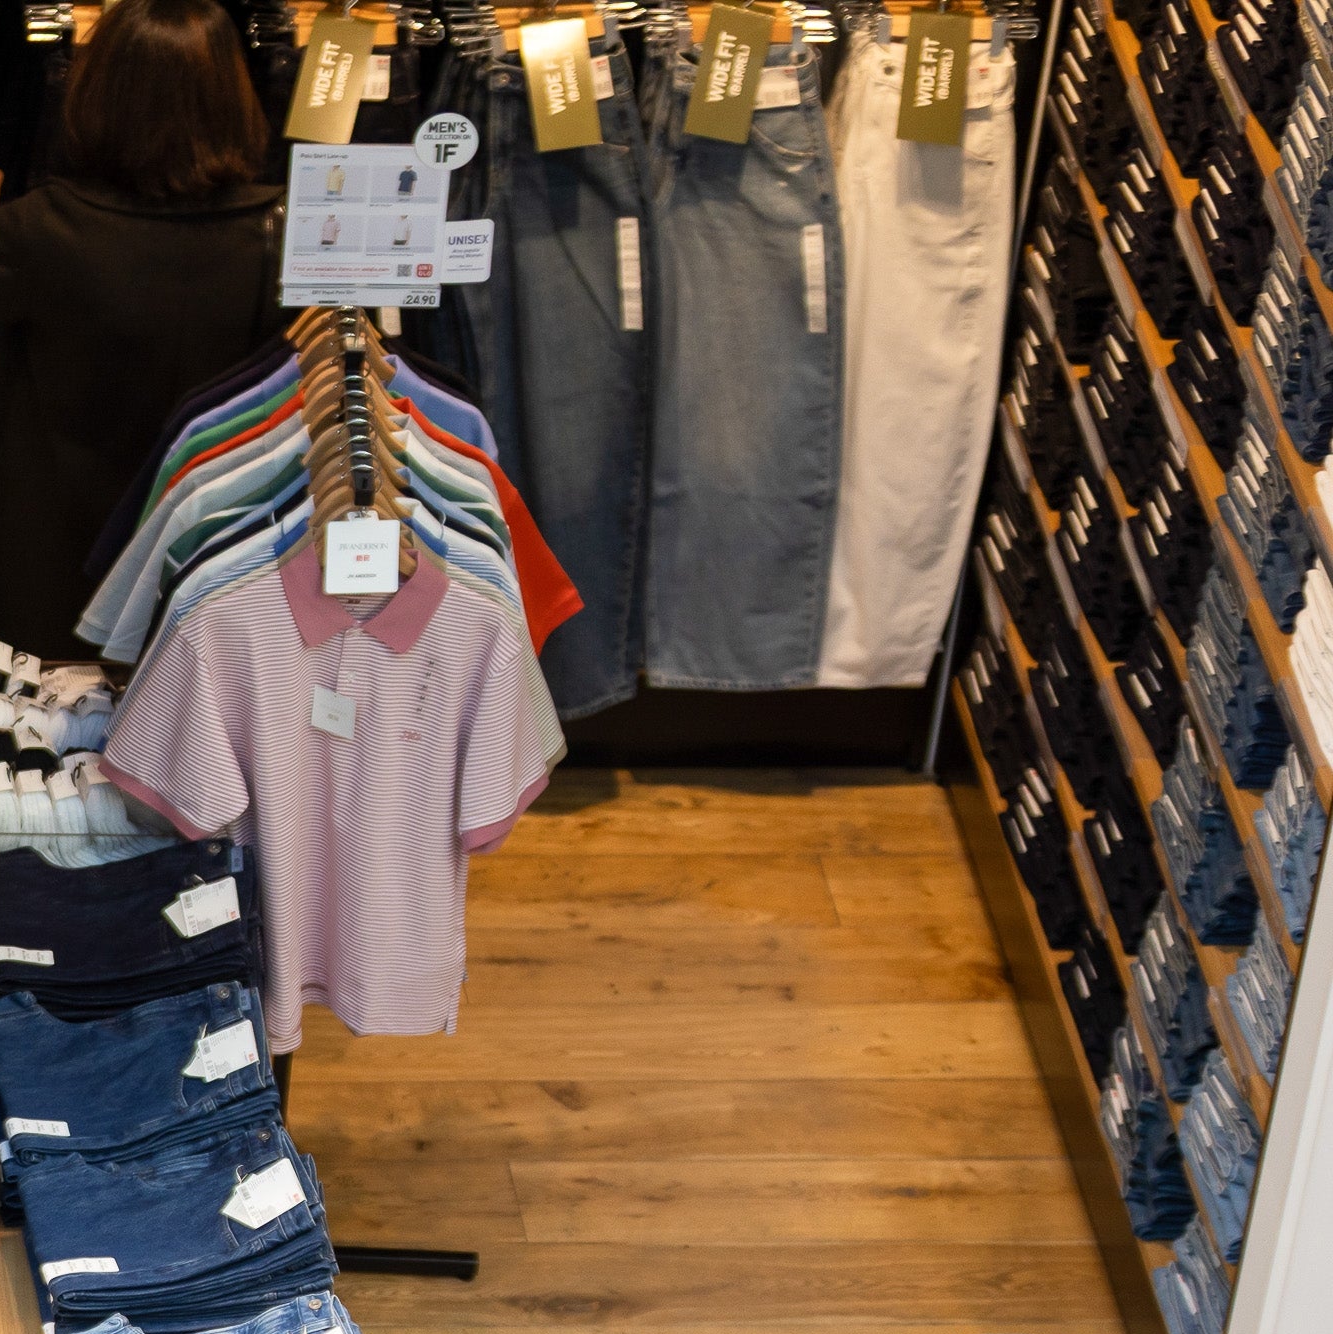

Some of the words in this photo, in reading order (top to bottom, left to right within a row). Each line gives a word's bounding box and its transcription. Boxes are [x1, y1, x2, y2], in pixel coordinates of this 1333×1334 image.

[321, 40, 341, 66] FIT
[716, 31, 738, 59] FIT
[921, 37, 941, 63] FIT
[309, 67, 335, 107] WIDE
[545, 72, 567, 115] WIDE
[706, 60, 732, 102] WIDE
[915, 66, 937, 107] WIDE
[428, 122, 468, 133] MEN'S
[435, 144, 459, 163] 1F
[448, 235, 489, 246] UNISEX
